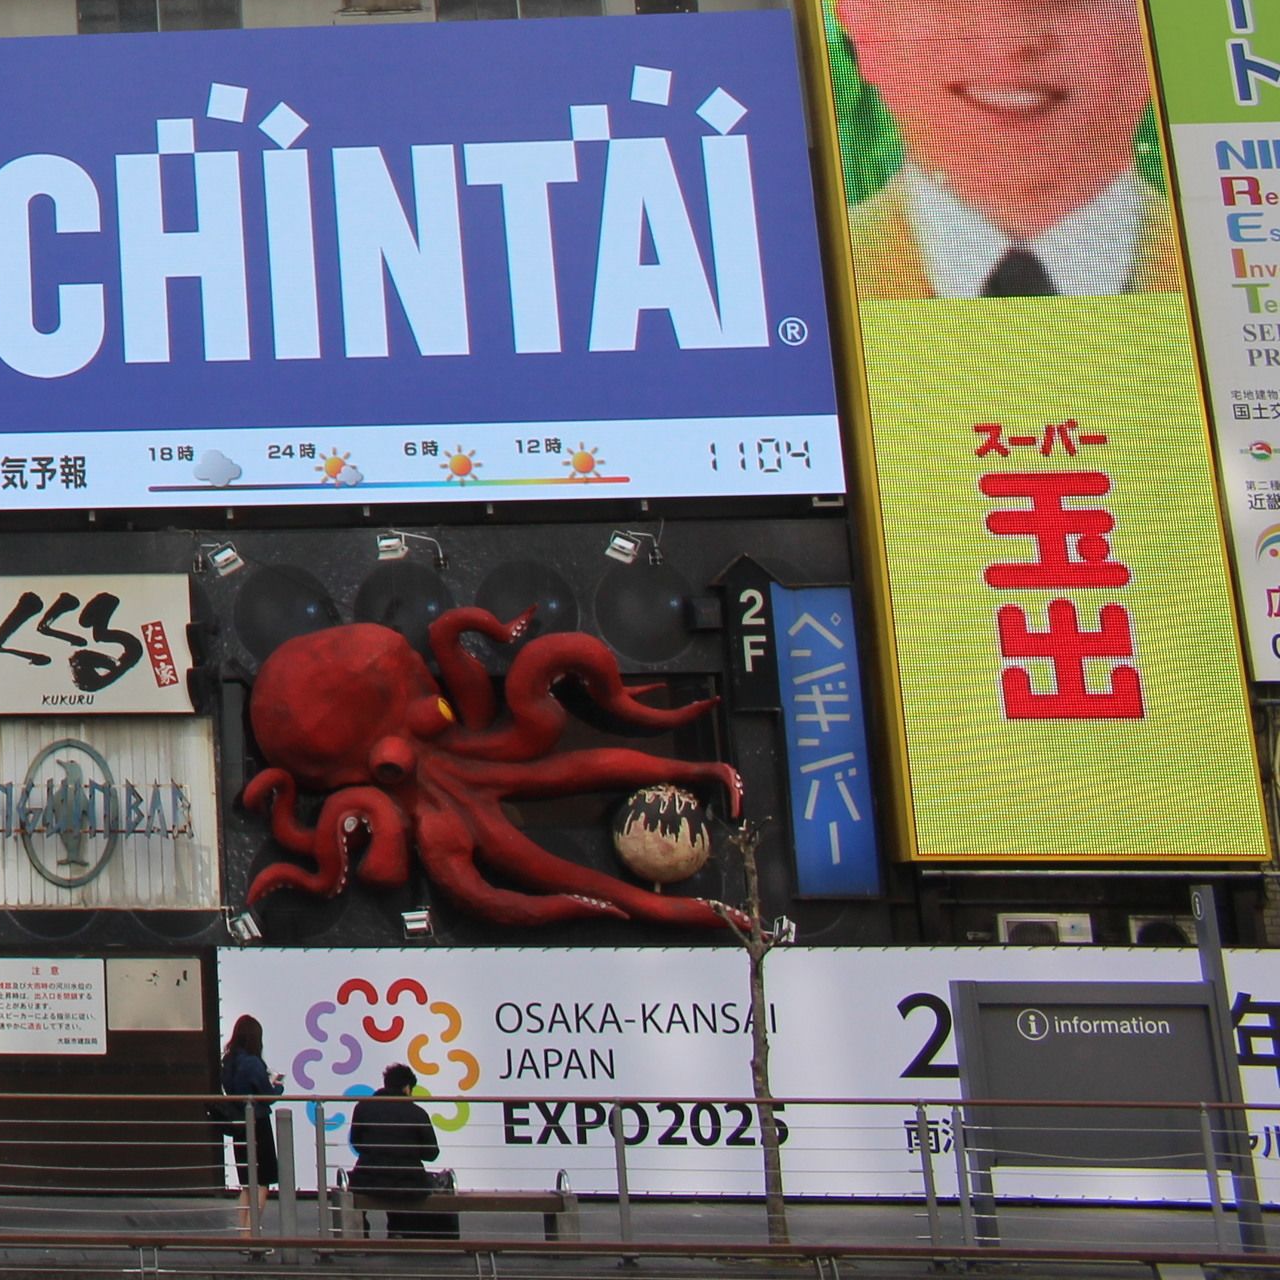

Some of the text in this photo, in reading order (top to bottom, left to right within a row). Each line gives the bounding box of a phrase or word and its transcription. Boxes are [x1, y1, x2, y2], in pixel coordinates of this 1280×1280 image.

[1242, 323, 1280, 342] SE
[148, 445, 194, 463] 18時
[268, 442, 316, 460] 24時
[404, 440, 439, 457] 6時
[514, 437, 562, 455] 12時
[973, 420, 1109, 458] スーパー
[978, 470, 1146, 721] 玉出
[42, 694, 95, 706] KUKURU
[788, 612, 861, 865] ペンギンバー
[1054, 1017, 1171, 1035] information
[498, 1048, 615, 1081] JAPAN
